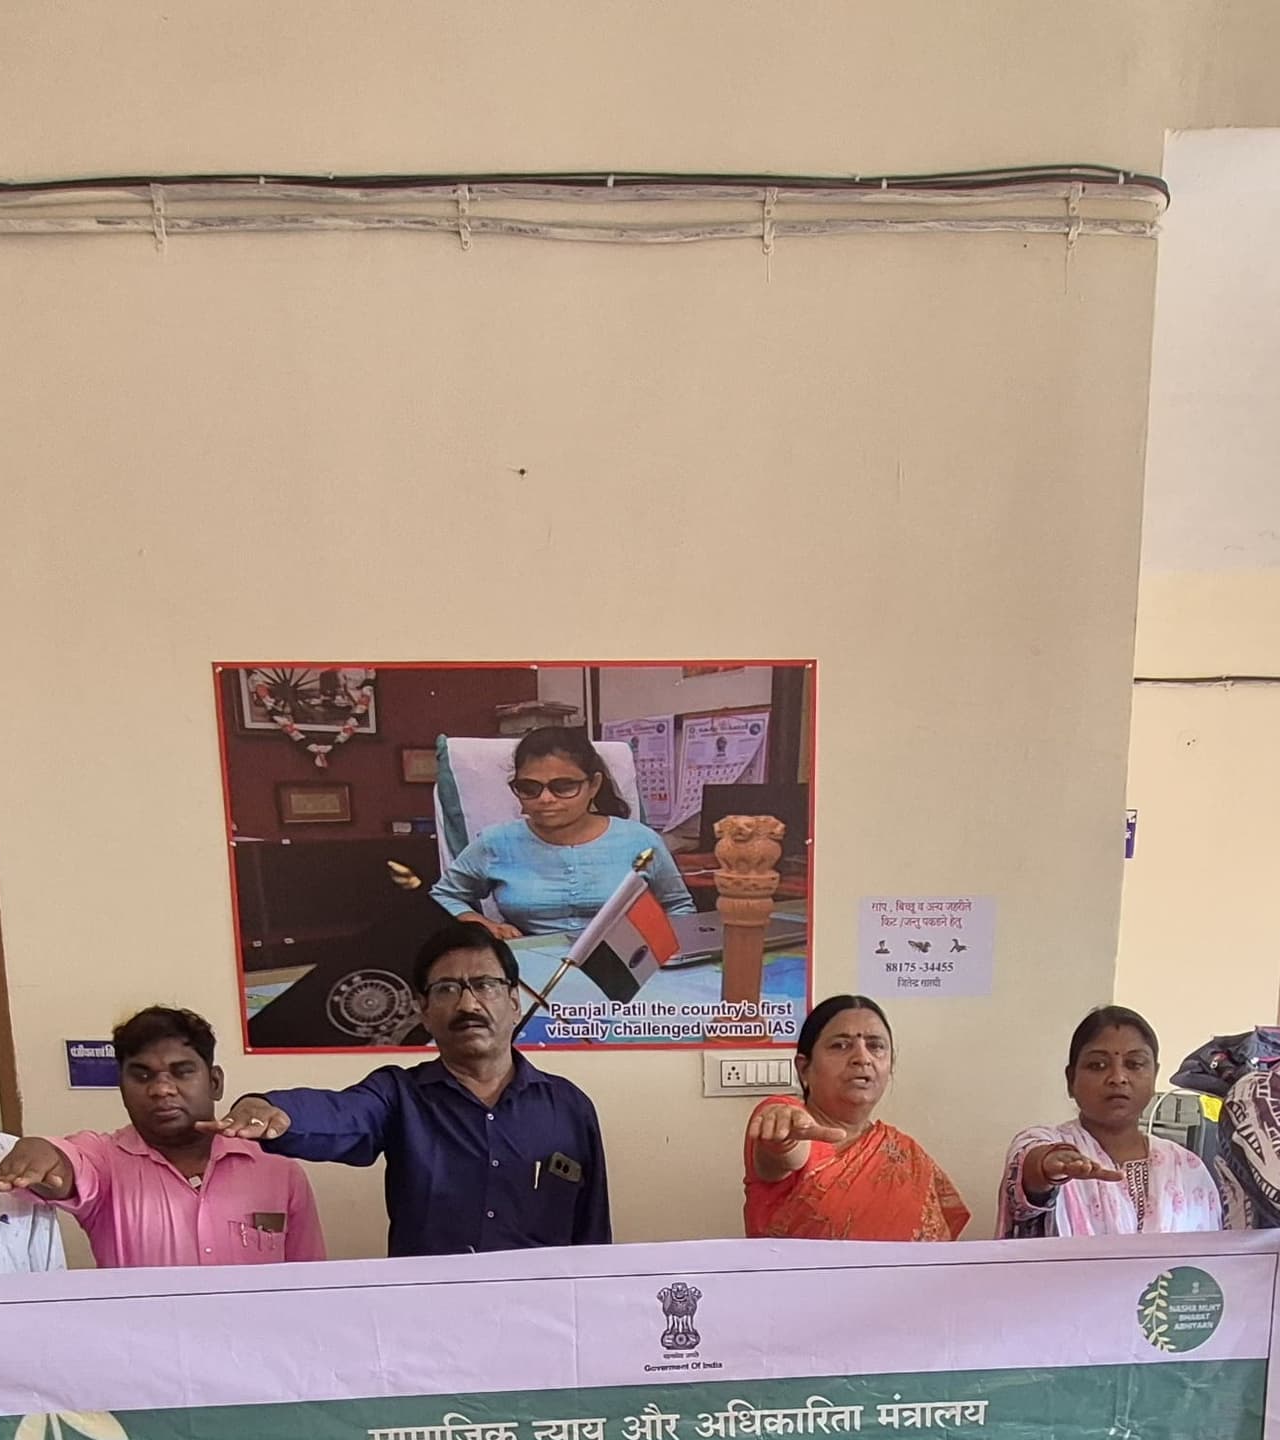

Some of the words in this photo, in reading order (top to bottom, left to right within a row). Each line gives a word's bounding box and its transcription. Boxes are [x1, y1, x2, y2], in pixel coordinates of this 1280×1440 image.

[551, 1002, 606, 1020] Pranjal
[612, 1001, 646, 1017] Patil
[651, 1001, 676, 1016] the
[680, 1001, 755, 1020] country's
[761, 1000, 792, 1016] first
[547, 1021, 608, 1039] visually
[616, 1020, 700, 1039] challenged
[705, 1021, 763, 1036] woman
[768, 1020, 795, 1035] IAS
[702, 1361, 723, 1370] India
[621, 1403, 680, 1440] और
[694, 1395, 864, 1439] अधिकारिता
[876, 1392, 989, 1430] मंत्रालय
